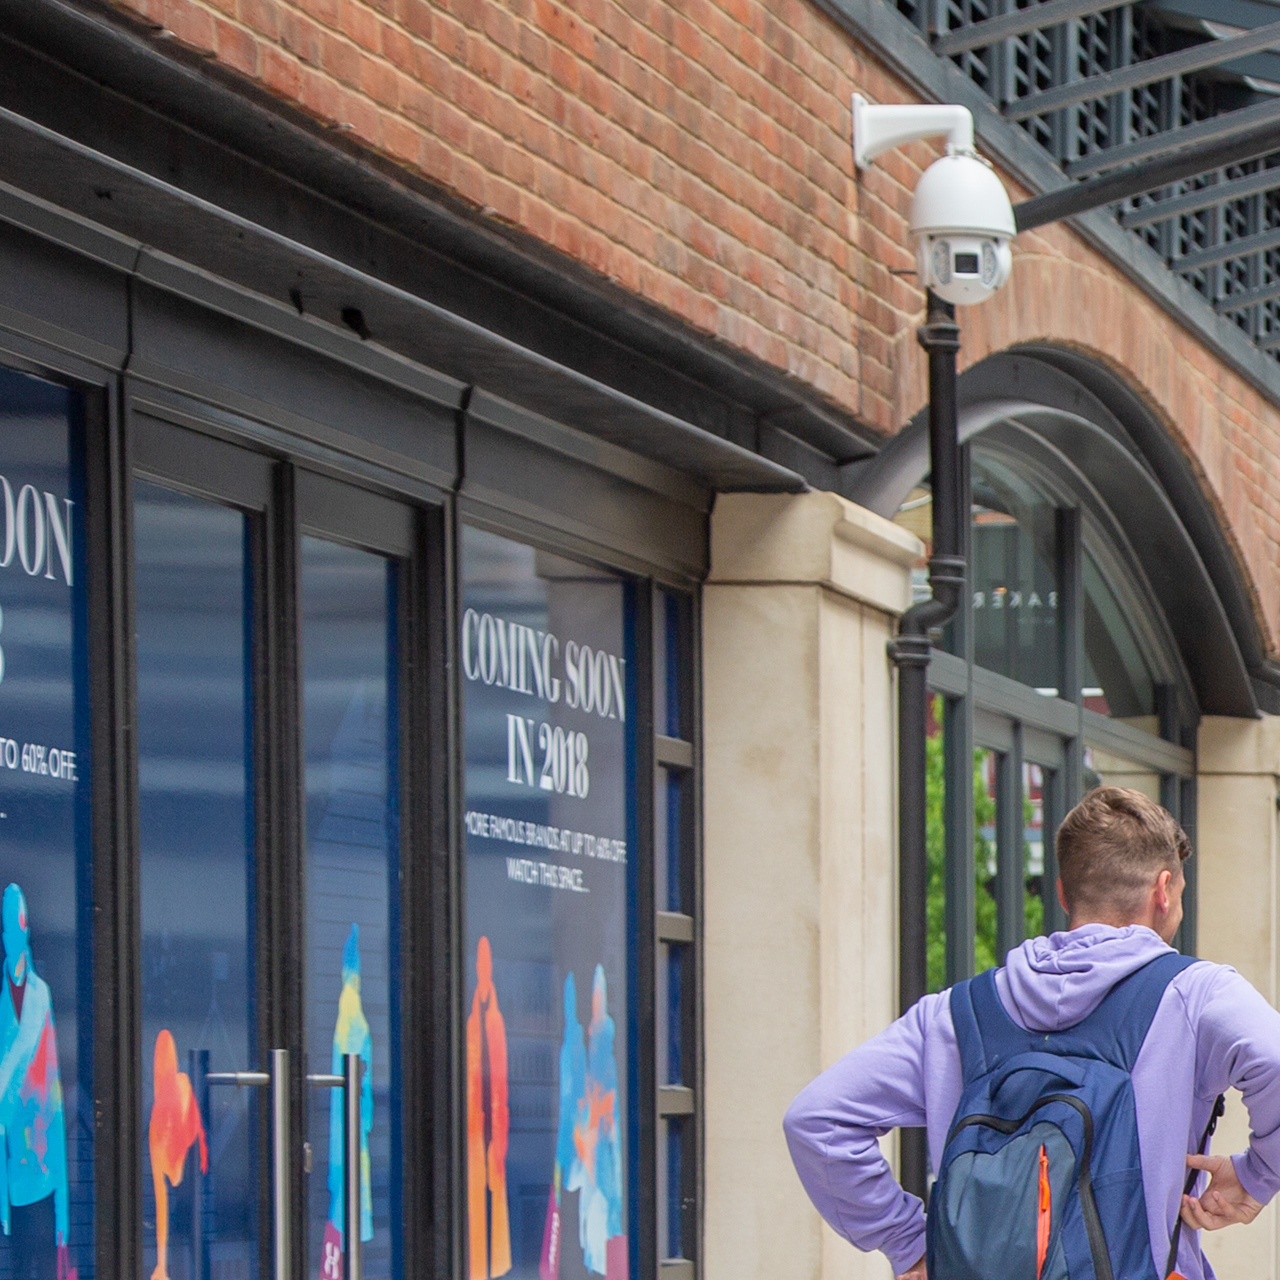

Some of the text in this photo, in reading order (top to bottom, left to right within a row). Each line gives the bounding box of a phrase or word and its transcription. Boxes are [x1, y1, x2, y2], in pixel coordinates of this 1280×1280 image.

[462, 607, 627, 722] COMING SOON
[21, 742, 48, 776] 60%
[506, 713, 590, 799] IN 2018
